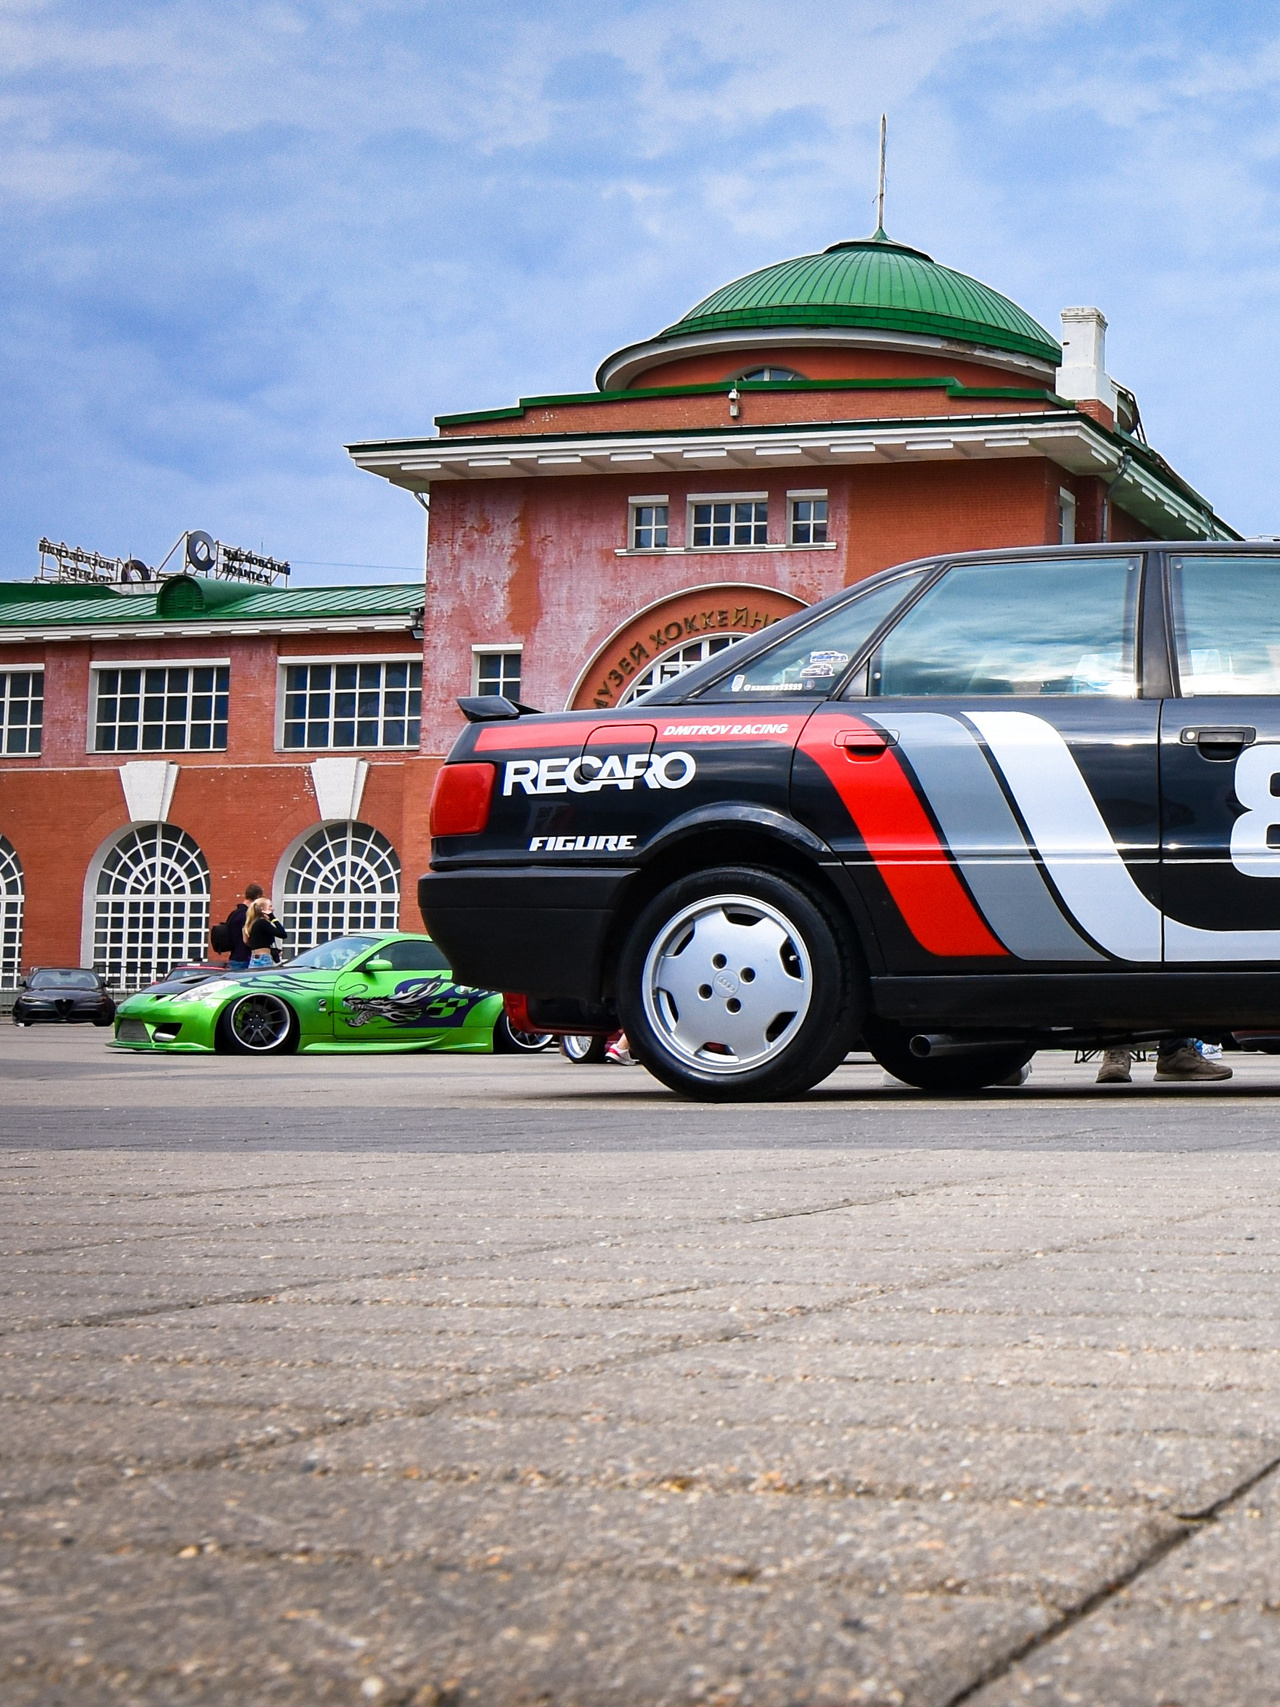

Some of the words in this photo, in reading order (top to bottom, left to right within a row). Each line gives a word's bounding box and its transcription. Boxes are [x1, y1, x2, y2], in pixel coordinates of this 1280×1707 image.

[650, 606, 782, 650] ХОККЕЙН
[663, 724, 730, 736] DMITROV
[729, 723, 789, 735] RACING
[502, 751, 696, 797] RECARO
[529, 834, 638, 852] FIGURE
